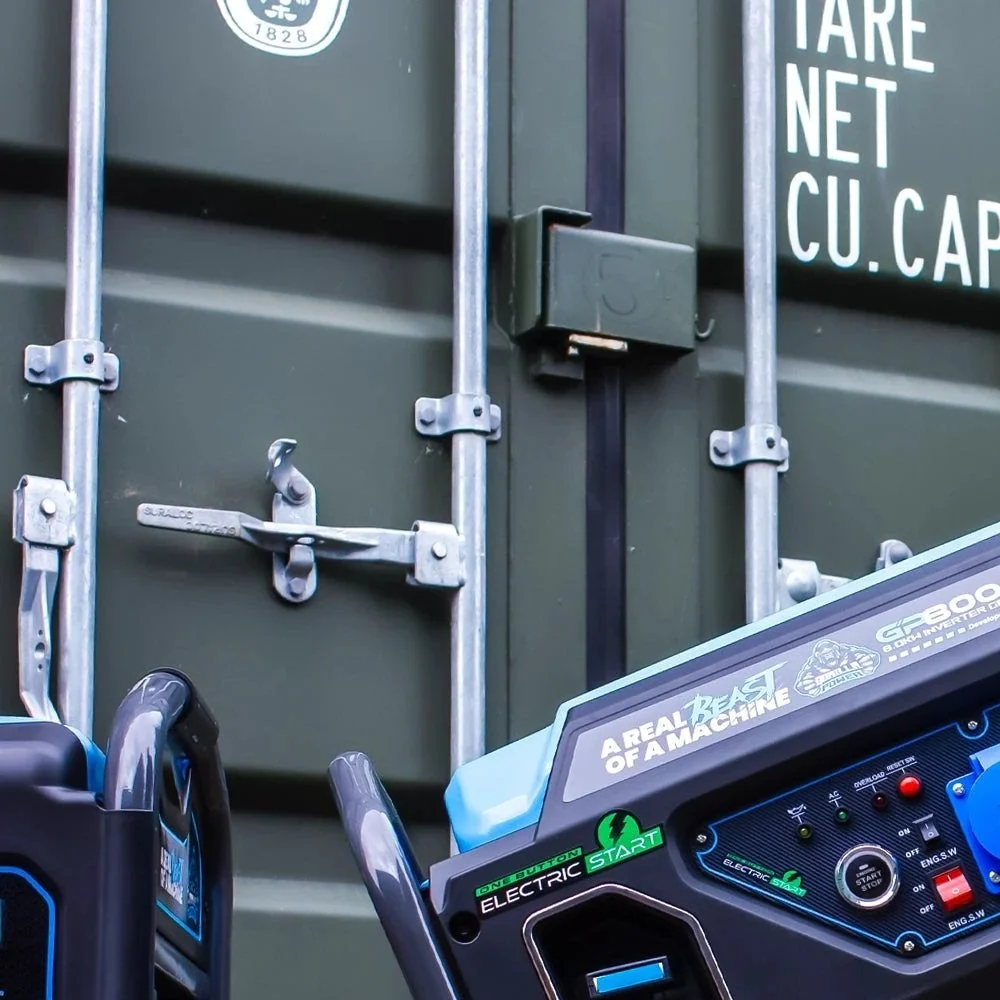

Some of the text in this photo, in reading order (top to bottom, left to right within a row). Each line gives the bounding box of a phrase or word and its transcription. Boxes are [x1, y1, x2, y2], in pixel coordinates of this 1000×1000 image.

[254, 23, 308, 43] 1828
[796, 0, 935, 73] TARE
[786, 62, 897, 169] NET
[923, 604, 987, 637] INVERTER
[600, 660, 788, 760] A REAL BEAST
[605, 687, 791, 774] OF A MACHINE
[853, 771, 885, 788] OVERLOAD
[898, 827, 911, 837] ON
[905, 847, 920, 858] OFF
[920, 847, 958, 869] ENG.S.W
[478, 850, 580, 894] ONE BUTTON
[480, 830, 660, 914] ELECTRIC START
[722, 858, 770, 882] ELECTRIC
[855, 869, 883, 887] START
[860, 877, 883, 893] STOP
[912, 883, 925, 893] ON
[919, 903, 935, 915] OFF
[948, 909, 986, 931] ENG.S.W
